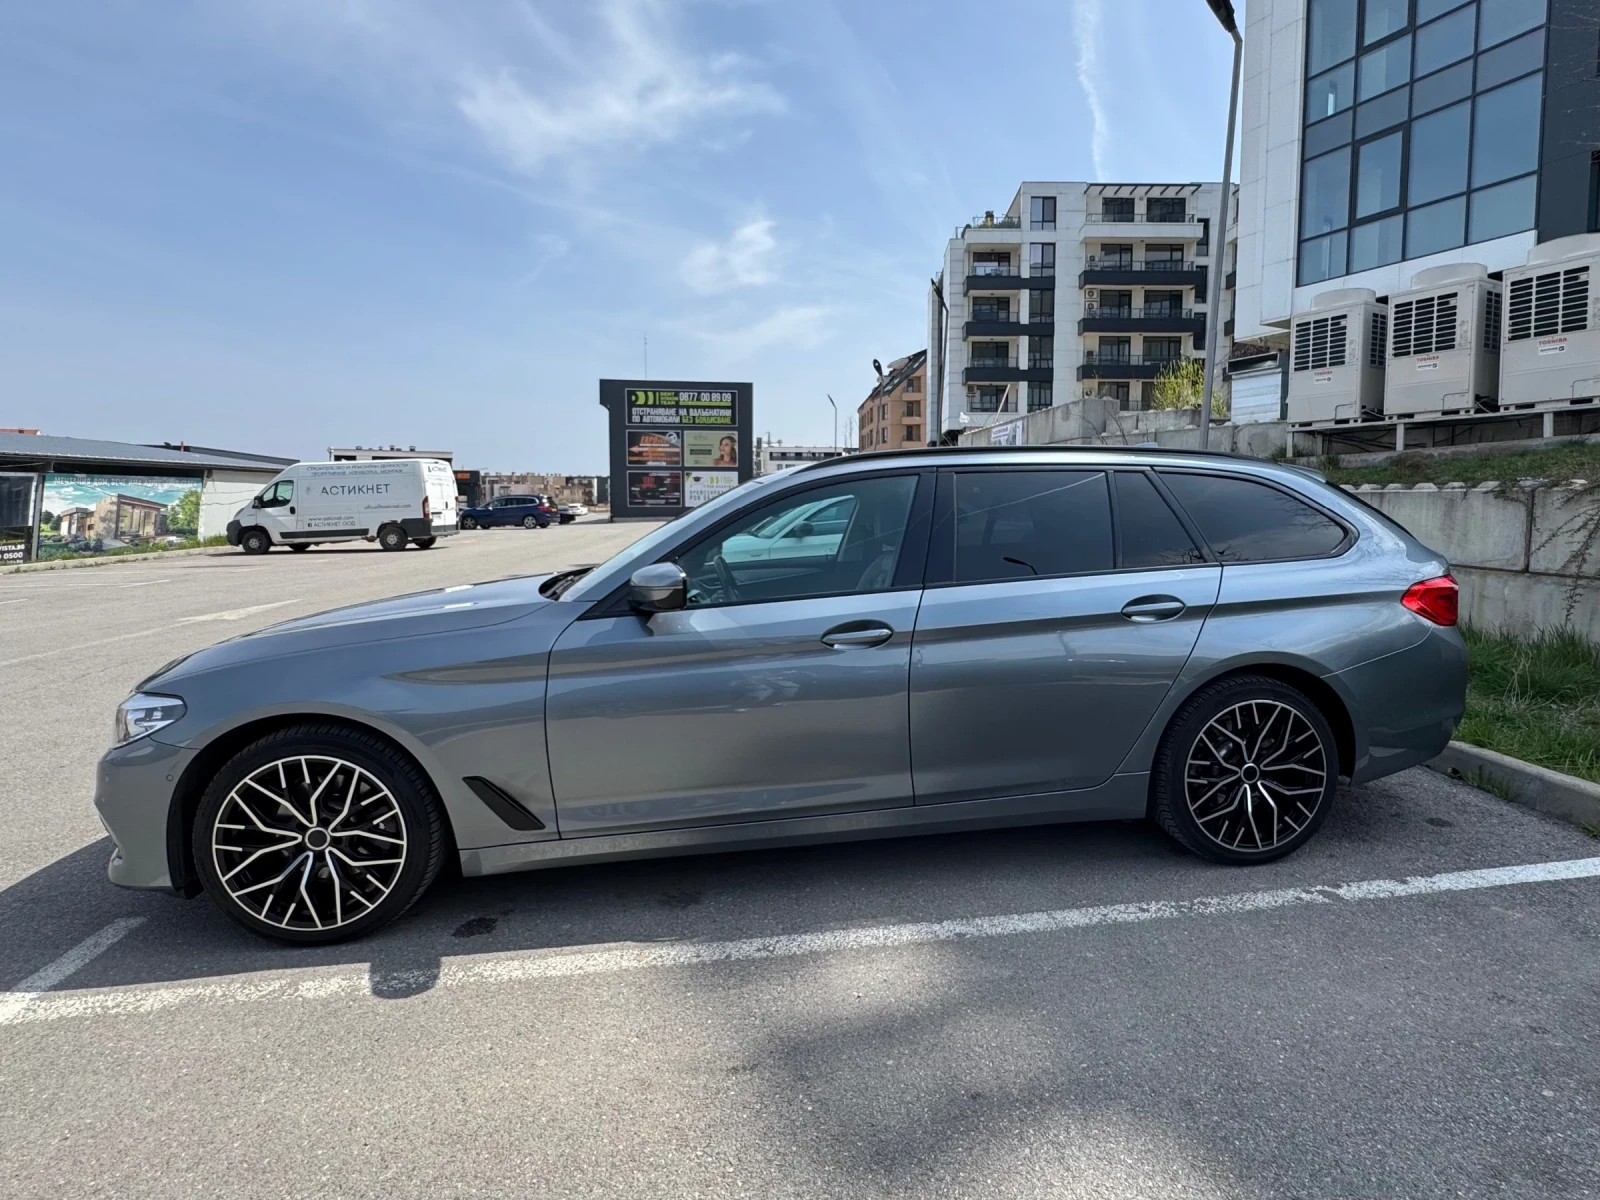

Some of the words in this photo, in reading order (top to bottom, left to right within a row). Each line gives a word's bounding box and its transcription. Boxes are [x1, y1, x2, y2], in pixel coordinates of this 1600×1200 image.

[1539, 337, 1568, 345] TOSHIBA
[679, 392, 698, 402] 0877
[700, 392, 710, 402] 00
[711, 393, 721, 402] 89
[722, 393, 732, 402] 09
[632, 408, 677, 416] ОТСТРАНЯВАНЕ
[679, 408, 688, 416] НА
[689, 409, 732, 417] ВДЛЪБНАТИНИ
[681, 416, 694, 424] БЕЗ
[695, 416, 732, 424] БОЯДИСВАНЕ
[321, 483, 391, 496] АСТИКНЕТ
[3, 551, 24, 560] 0500
